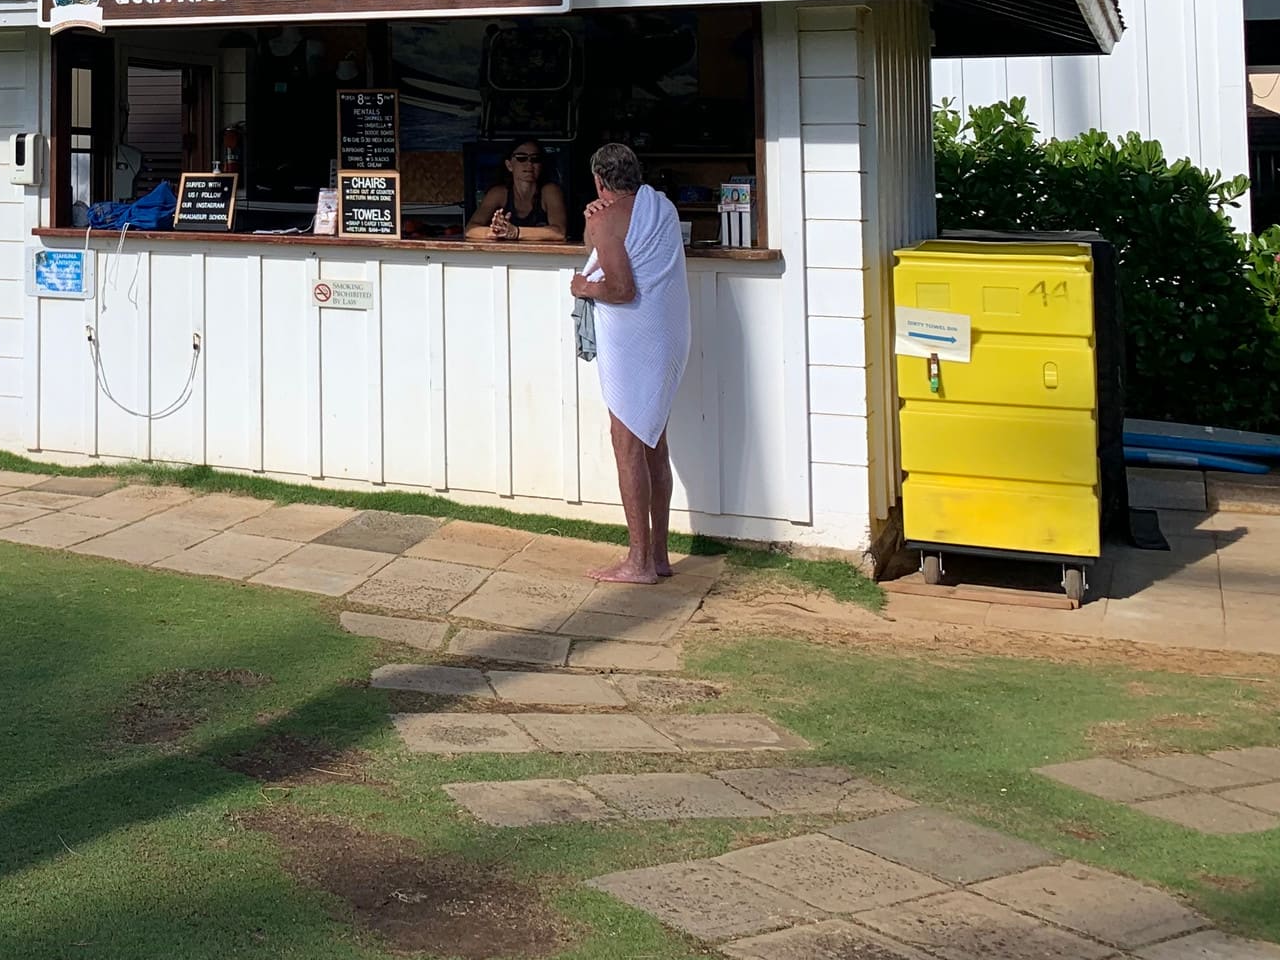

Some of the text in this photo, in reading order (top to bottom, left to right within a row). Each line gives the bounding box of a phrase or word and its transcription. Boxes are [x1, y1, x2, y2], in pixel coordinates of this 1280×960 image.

[351, 177, 387, 189] CHAIRS
[352, 208, 391, 221] TOWELS
[332, 282, 364, 290] SMOKING
[332, 290, 372, 298] PROHIBITED
